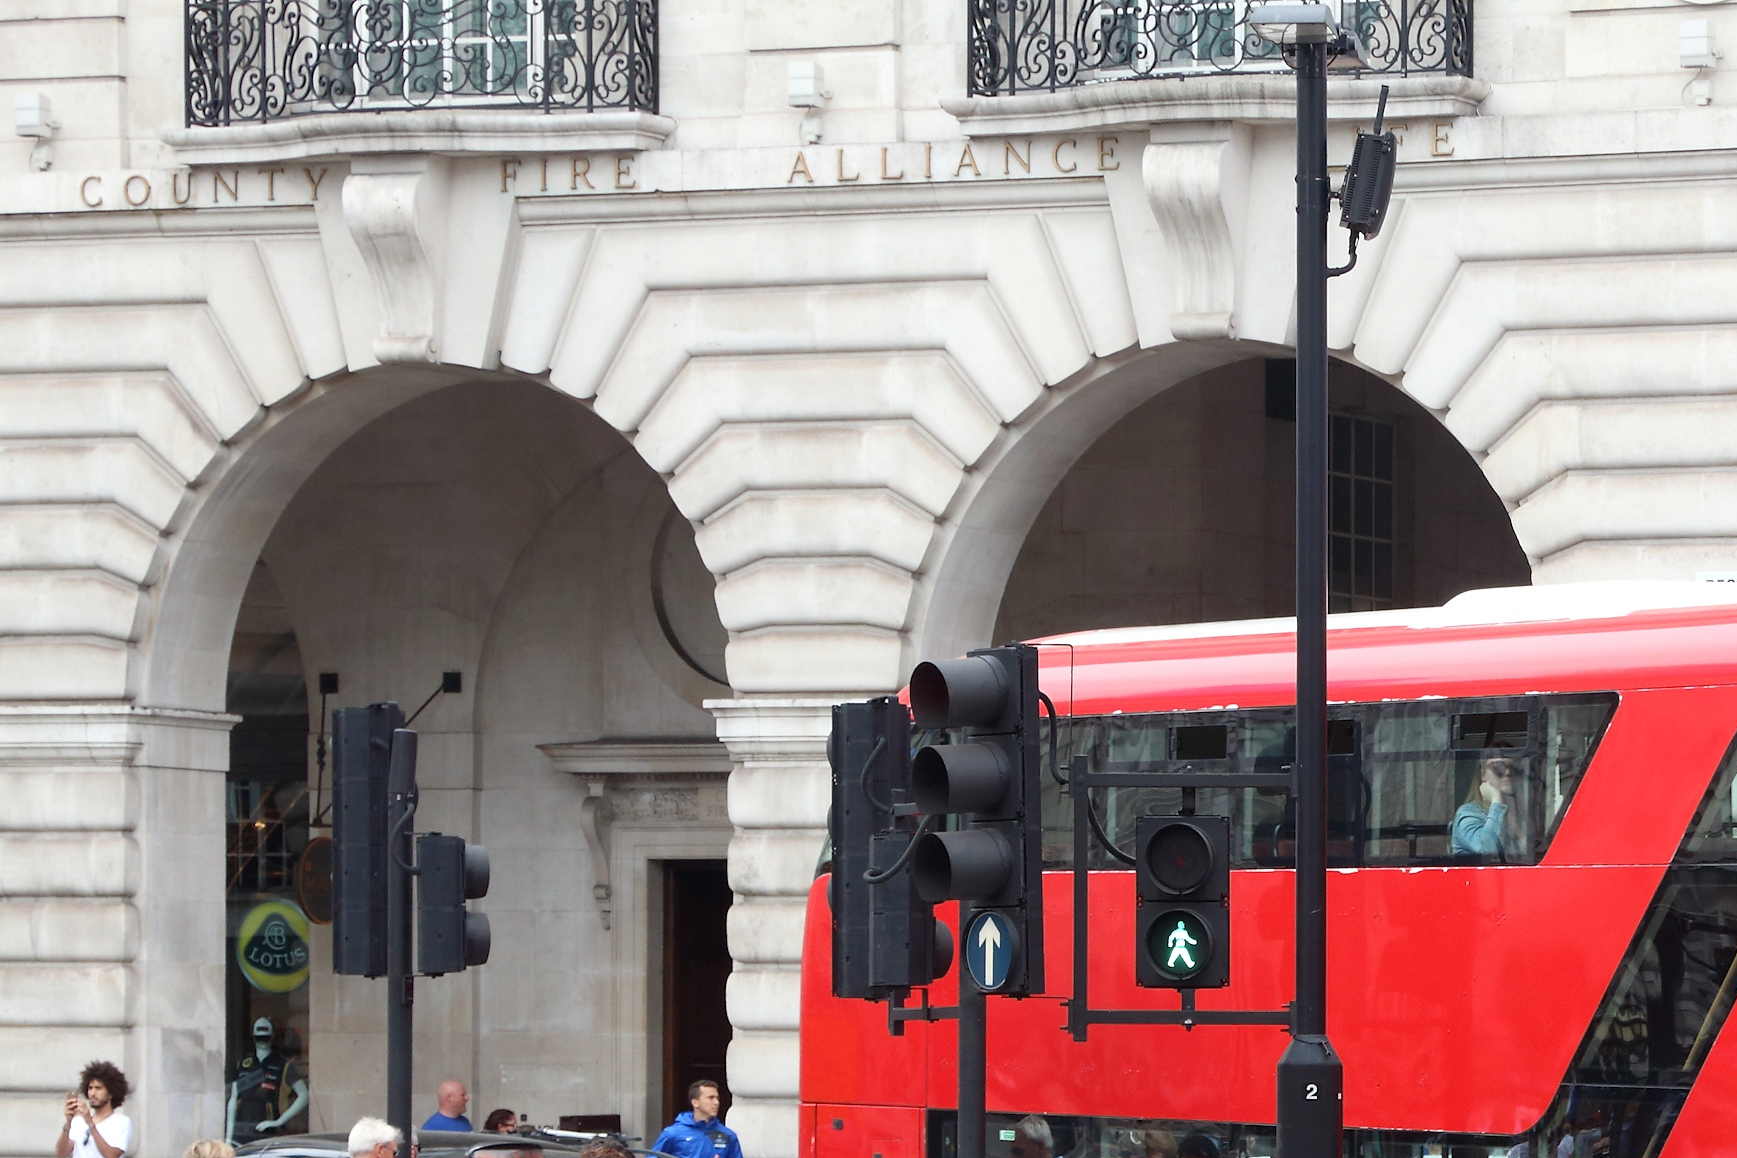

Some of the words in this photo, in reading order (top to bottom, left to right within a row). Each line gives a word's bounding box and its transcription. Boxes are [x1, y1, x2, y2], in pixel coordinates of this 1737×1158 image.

[80, 168, 328, 208] COUNTY
[500, 154, 637, 194] FIRE
[787, 136, 1121, 183] ALLIANCE
[249, 947, 306, 969] LOTUS
[1305, 1083, 1318, 1100] 2
